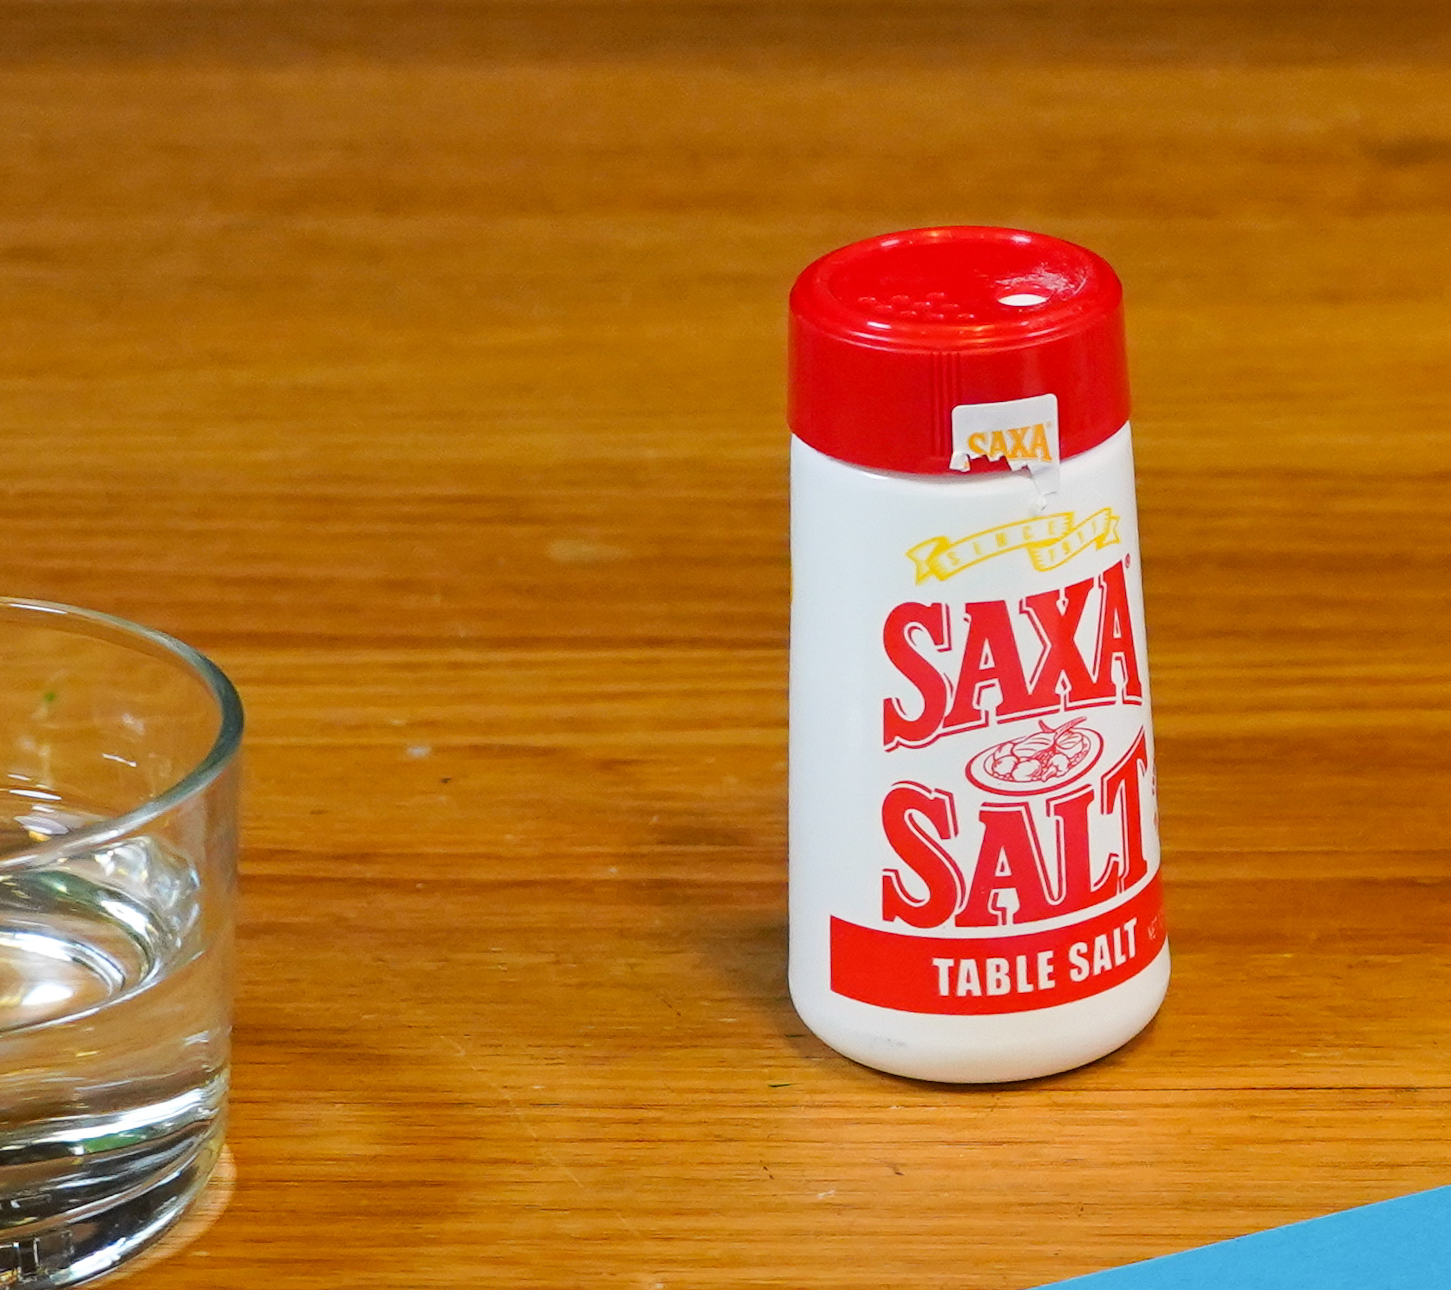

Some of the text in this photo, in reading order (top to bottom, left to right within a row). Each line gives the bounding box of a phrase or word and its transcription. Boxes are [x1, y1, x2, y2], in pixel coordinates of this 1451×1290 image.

[967, 423, 1053, 463] SAXA
[947, 521, 1056, 566] SINCE
[882, 560, 1144, 751] SAXA
[881, 725, 1149, 929] SALT
[932, 951, 1055, 997] TABLE
[1069, 918, 1137, 981] SALT
